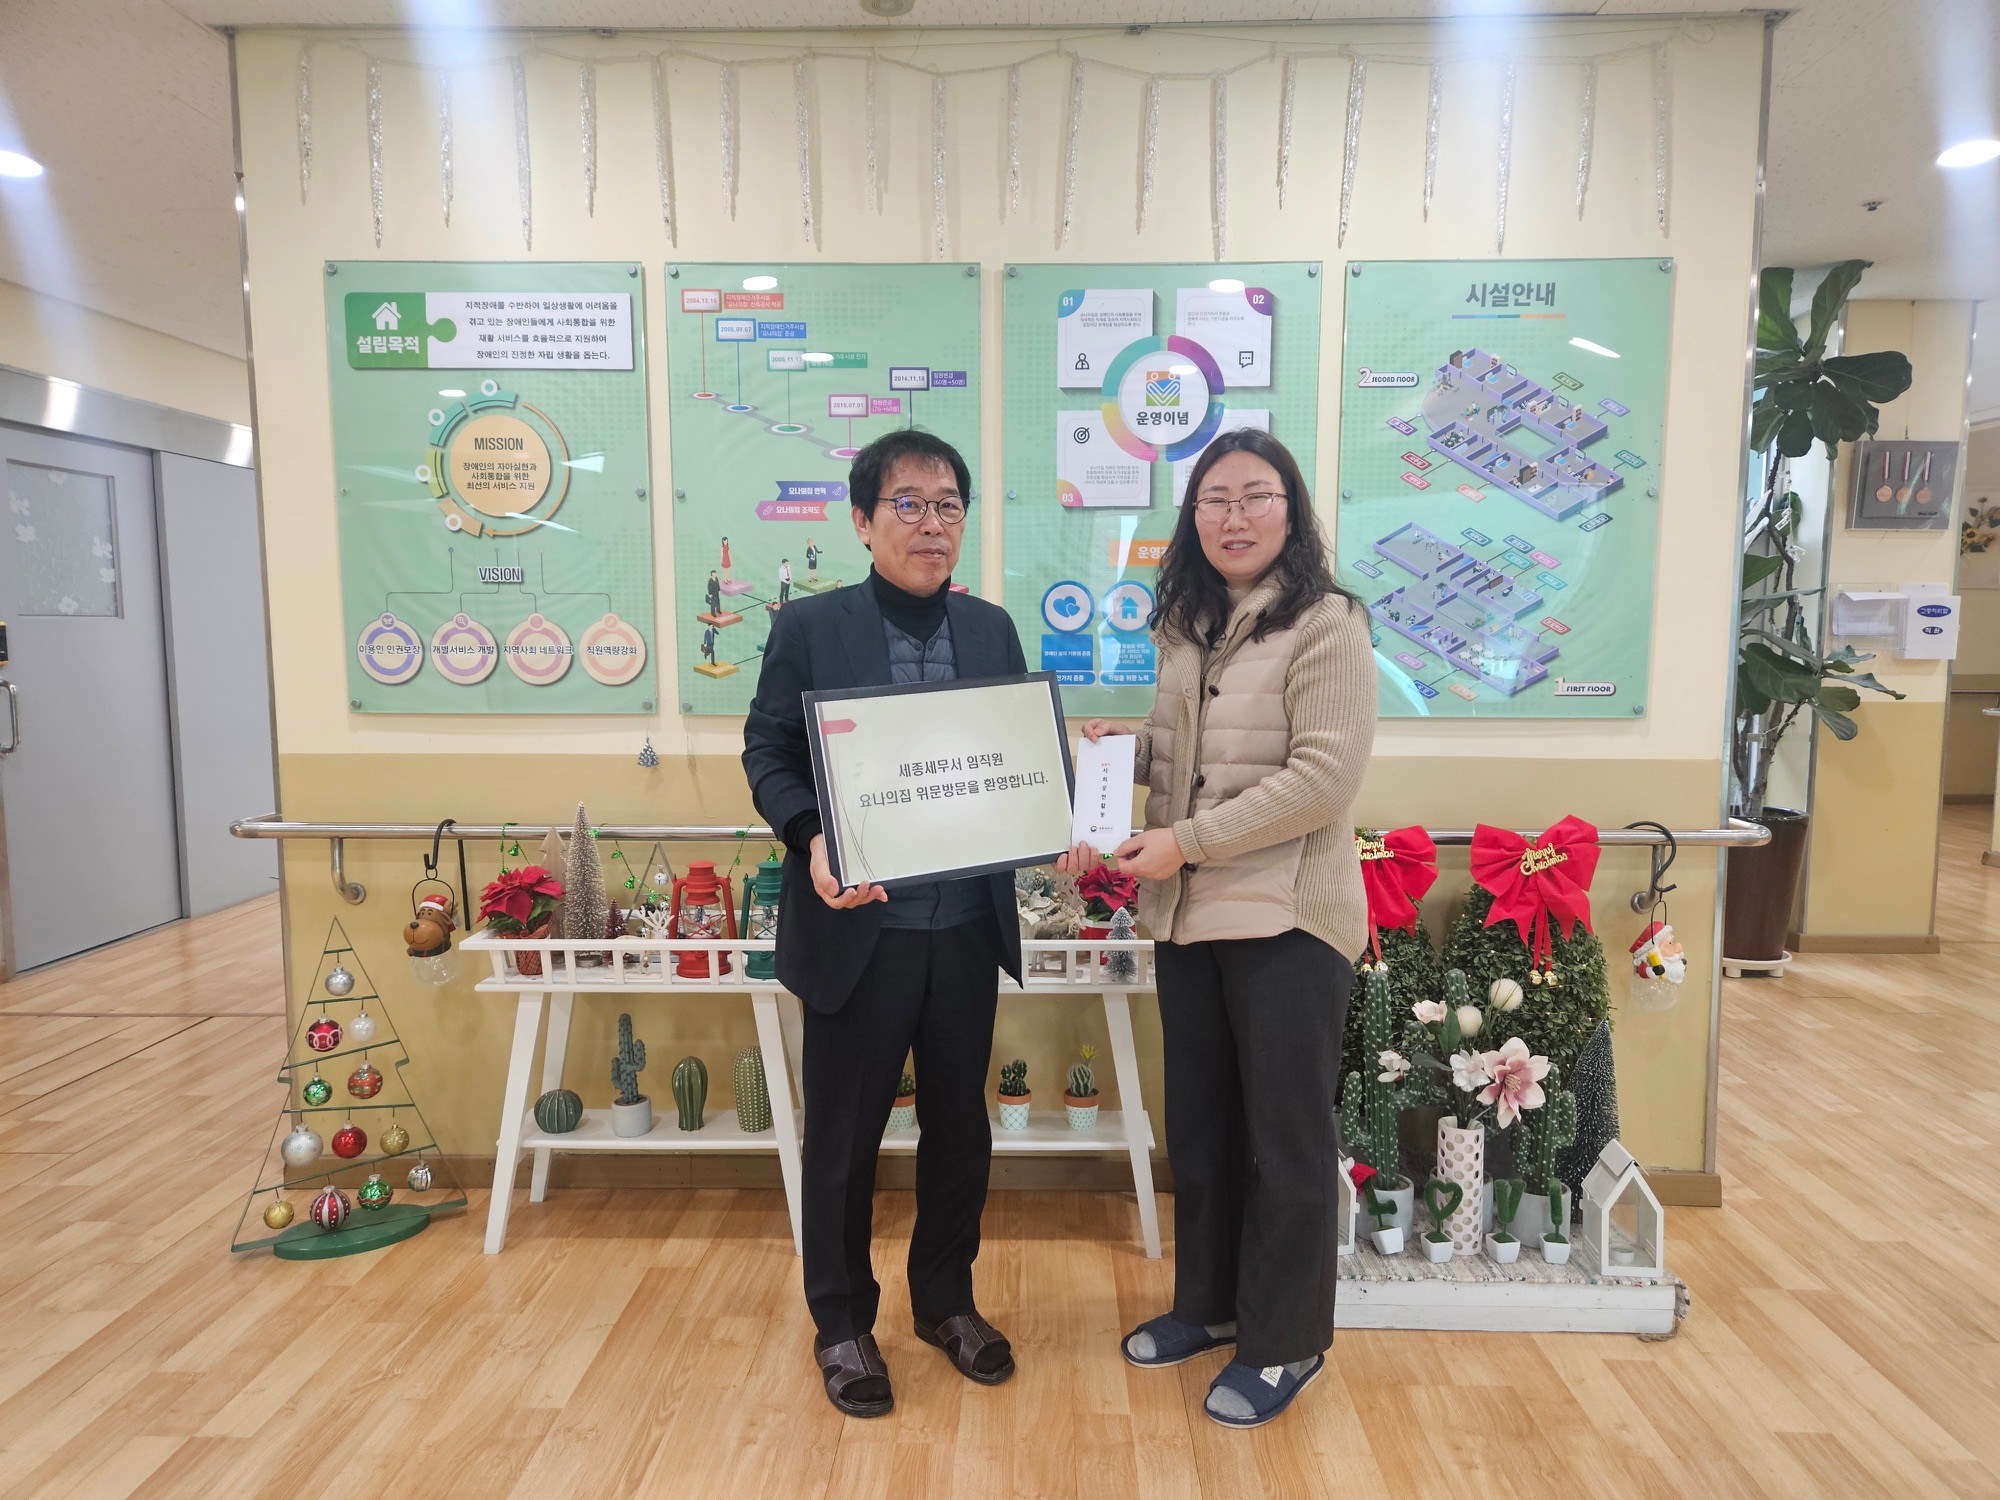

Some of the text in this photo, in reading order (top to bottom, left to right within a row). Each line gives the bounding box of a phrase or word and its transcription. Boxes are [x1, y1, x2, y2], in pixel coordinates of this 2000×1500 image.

[1252, 294, 1265, 305] 02
[1465, 282, 1556, 307] 시설안내
[465, 301, 618, 310] 지적장애를 수반하여 일상생활에 어려움을
[1062, 296, 1074, 306] 01
[469, 318, 615, 327] 겪고 있는 장애인들에게 사회통합을 위한
[479, 334, 607, 343] 재활 서비스를 효율적으로 지원하여
[356, 335, 420, 353] 설립목적
[476, 350, 611, 359] 장애인의 진정한 자립 생활을 돕는다.
[1357, 367, 1372, 387] 2
[1136, 411, 1189, 426] 운영이념
[474, 438, 524, 450] MISSION
[463, 462, 537, 471] 장애인의 자아실현과
[471, 472, 529, 481] 사회통합을 위한
[466, 481, 535, 490] 최선의 서비스 지원
[788, 487, 813, 495] 요나의집
[1062, 493, 1074, 503] 03
[776, 506, 800, 514] 요나의집
[1137, 546, 1167, 559] 운영
[478, 567, 521, 581] VISION
[358, 645, 420, 655] 이용인 인권보장
[432, 645, 495, 655] 개별서비스 개발
[502, 645, 574, 655] 지역사회 네트워크
[586, 645, 637, 655] 직원역량강화
[899, 752, 1004, 778] 세종세무서 임직원
[859, 771, 1049, 808] 요나의집 위문방문을 환영합니다.
[1355, 837, 1385, 854] Merry
[1360, 849, 1395, 861] hristmas
[1522, 843, 1556, 862] Merry
[1520, 852, 1568, 876] Christmas
